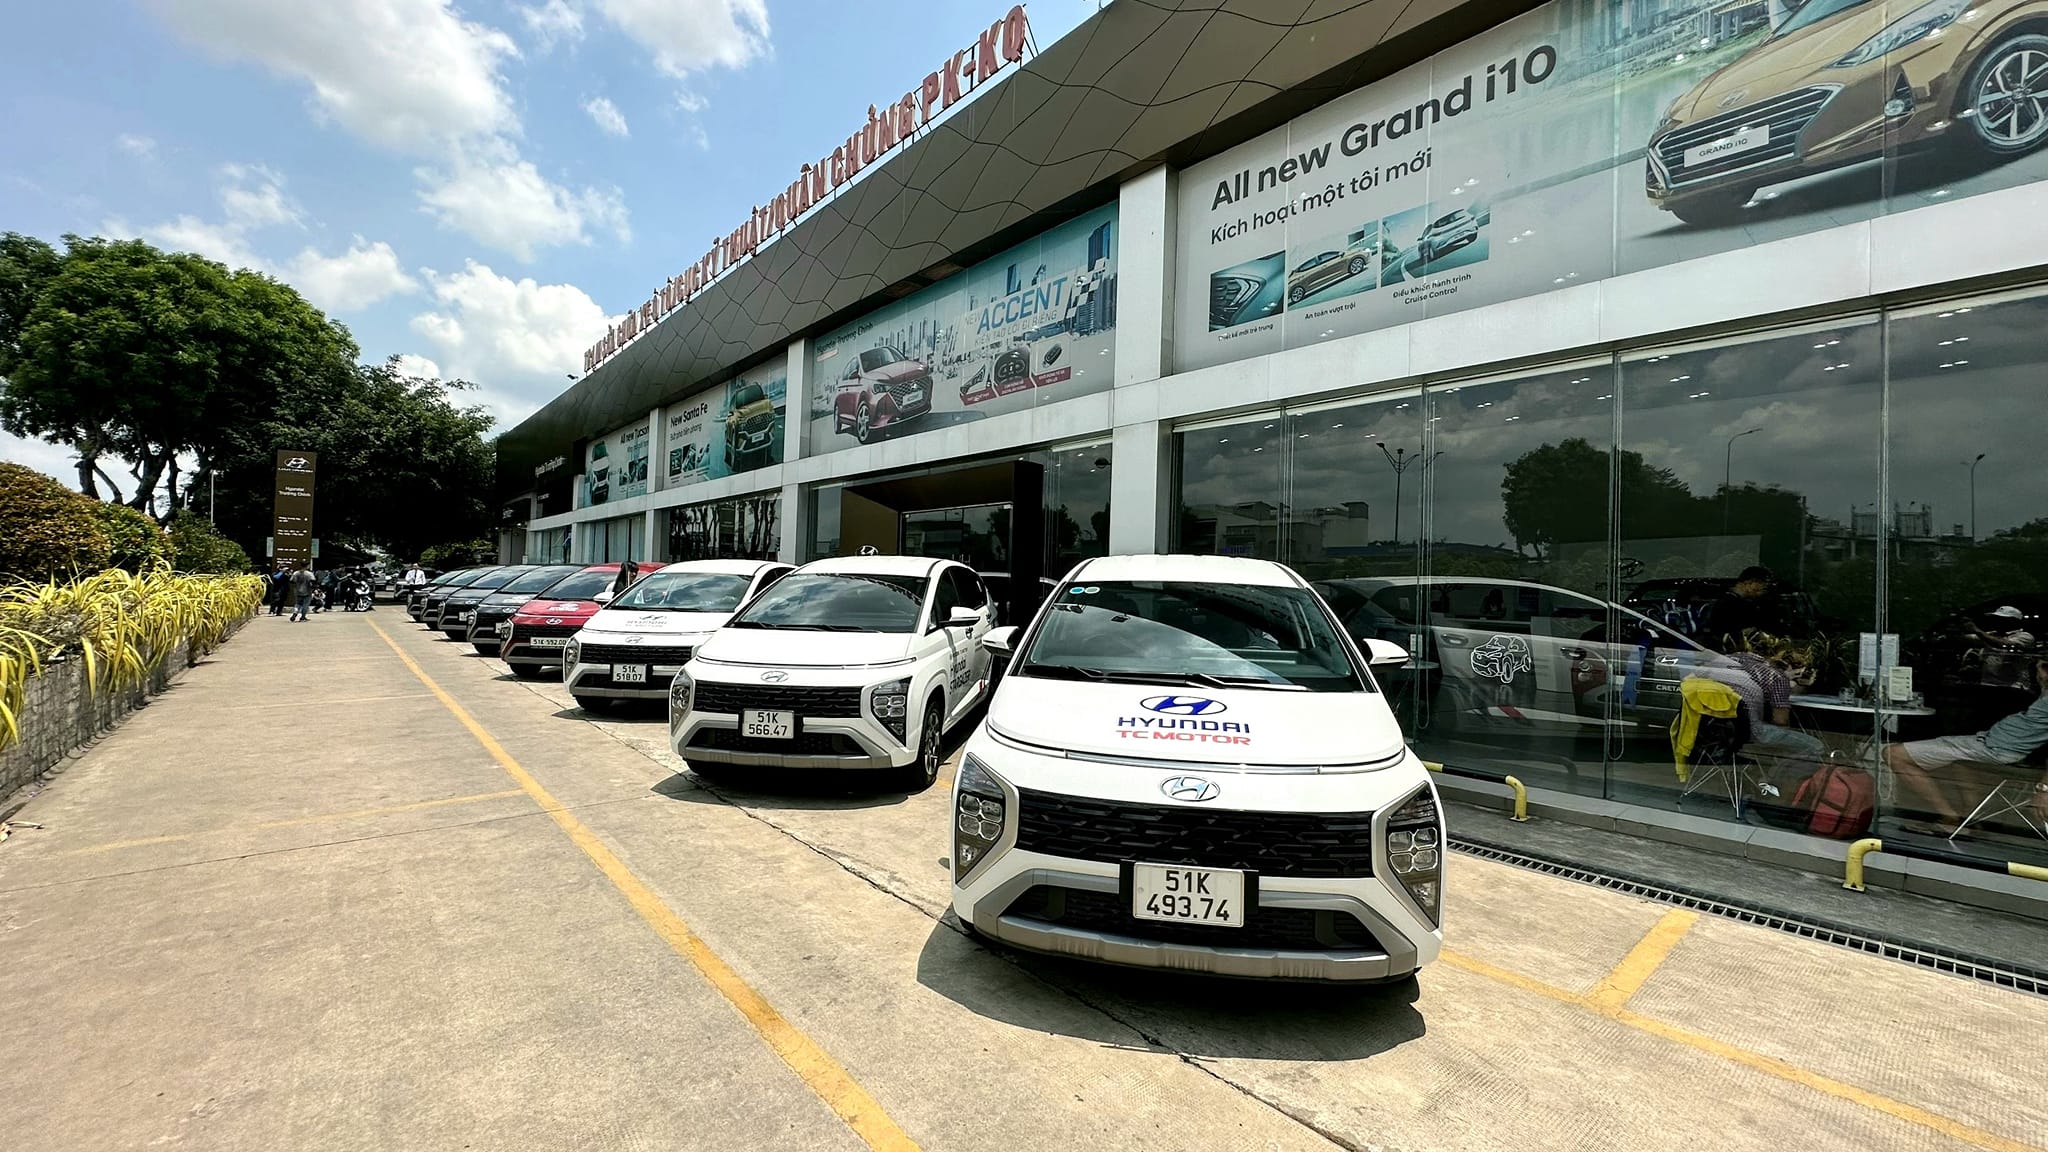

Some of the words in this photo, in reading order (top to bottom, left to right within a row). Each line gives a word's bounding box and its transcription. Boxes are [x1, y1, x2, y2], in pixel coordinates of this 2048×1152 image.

[830, 92, 916, 188] CHỦNG
[921, 4, 1026, 125] PK-KQ
[1211, 168, 1250, 211] All
[1257, 141, 1332, 194] new
[1340, 76, 1472, 157] Grand
[1485, 44, 1557, 102] i10
[1699, 142, 1734, 157] GRAND
[1734, 138, 1748, 149] i10
[1211, 212, 1248, 245] Kích
[1252, 201, 1298, 232] hoạt
[1302, 183, 1345, 213] một
[1349, 172, 1380, 197] tôi
[1385, 147, 1433, 181] mới
[976, 276, 1068, 335] ACCENT
[1404, 293, 1428, 305] Cruise
[1428, 286, 1458, 299] Control
[670, 415, 683, 429] New
[683, 406, 700, 423] Santa
[700, 402, 708, 415] Fe
[622, 665, 636, 673] 51K
[757, 711, 778, 724] 51K
[1117, 716, 1250, 734] HYUNDAI
[748, 723, 788, 737] 566.47
[1116, 729, 1153, 740] TC
[1153, 731, 1251, 746] MOTOR
[1165, 869, 1210, 895] 51K
[1146, 892, 1230, 921] 493.74
